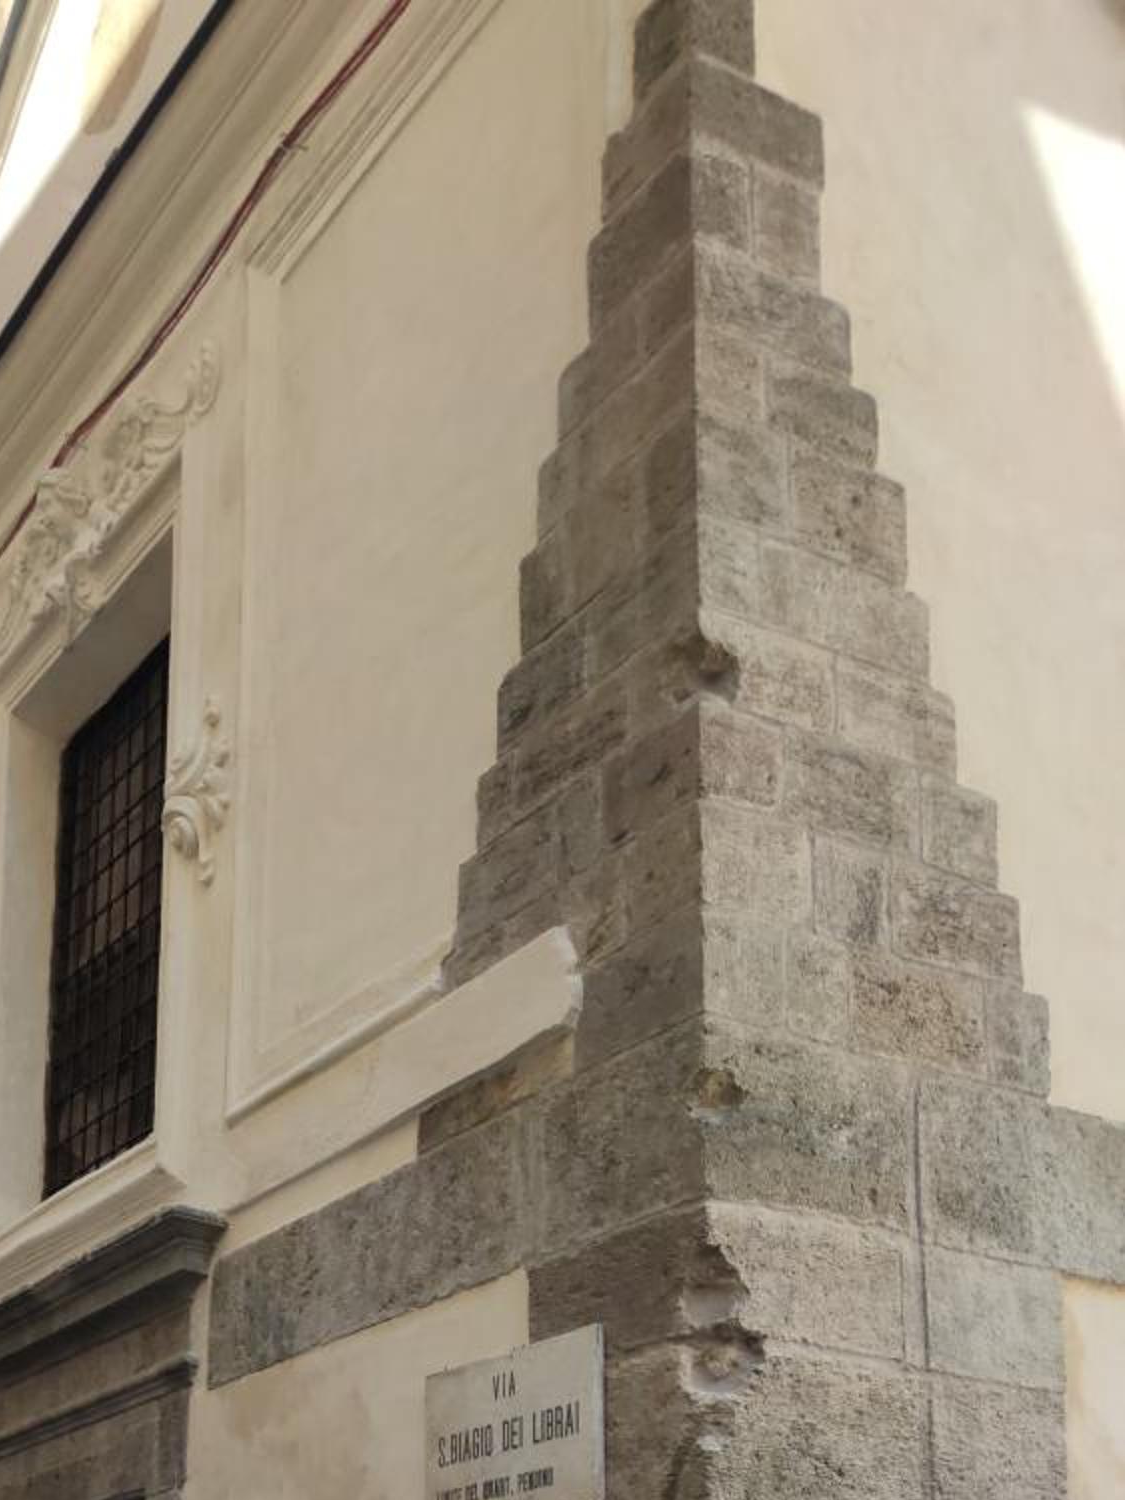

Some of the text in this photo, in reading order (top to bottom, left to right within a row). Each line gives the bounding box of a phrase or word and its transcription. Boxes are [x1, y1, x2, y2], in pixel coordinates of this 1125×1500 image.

[492, 1371, 516, 1400] VIA
[502, 1416, 524, 1451] DEI
[532, 1400, 580, 1444] LIBRAI
